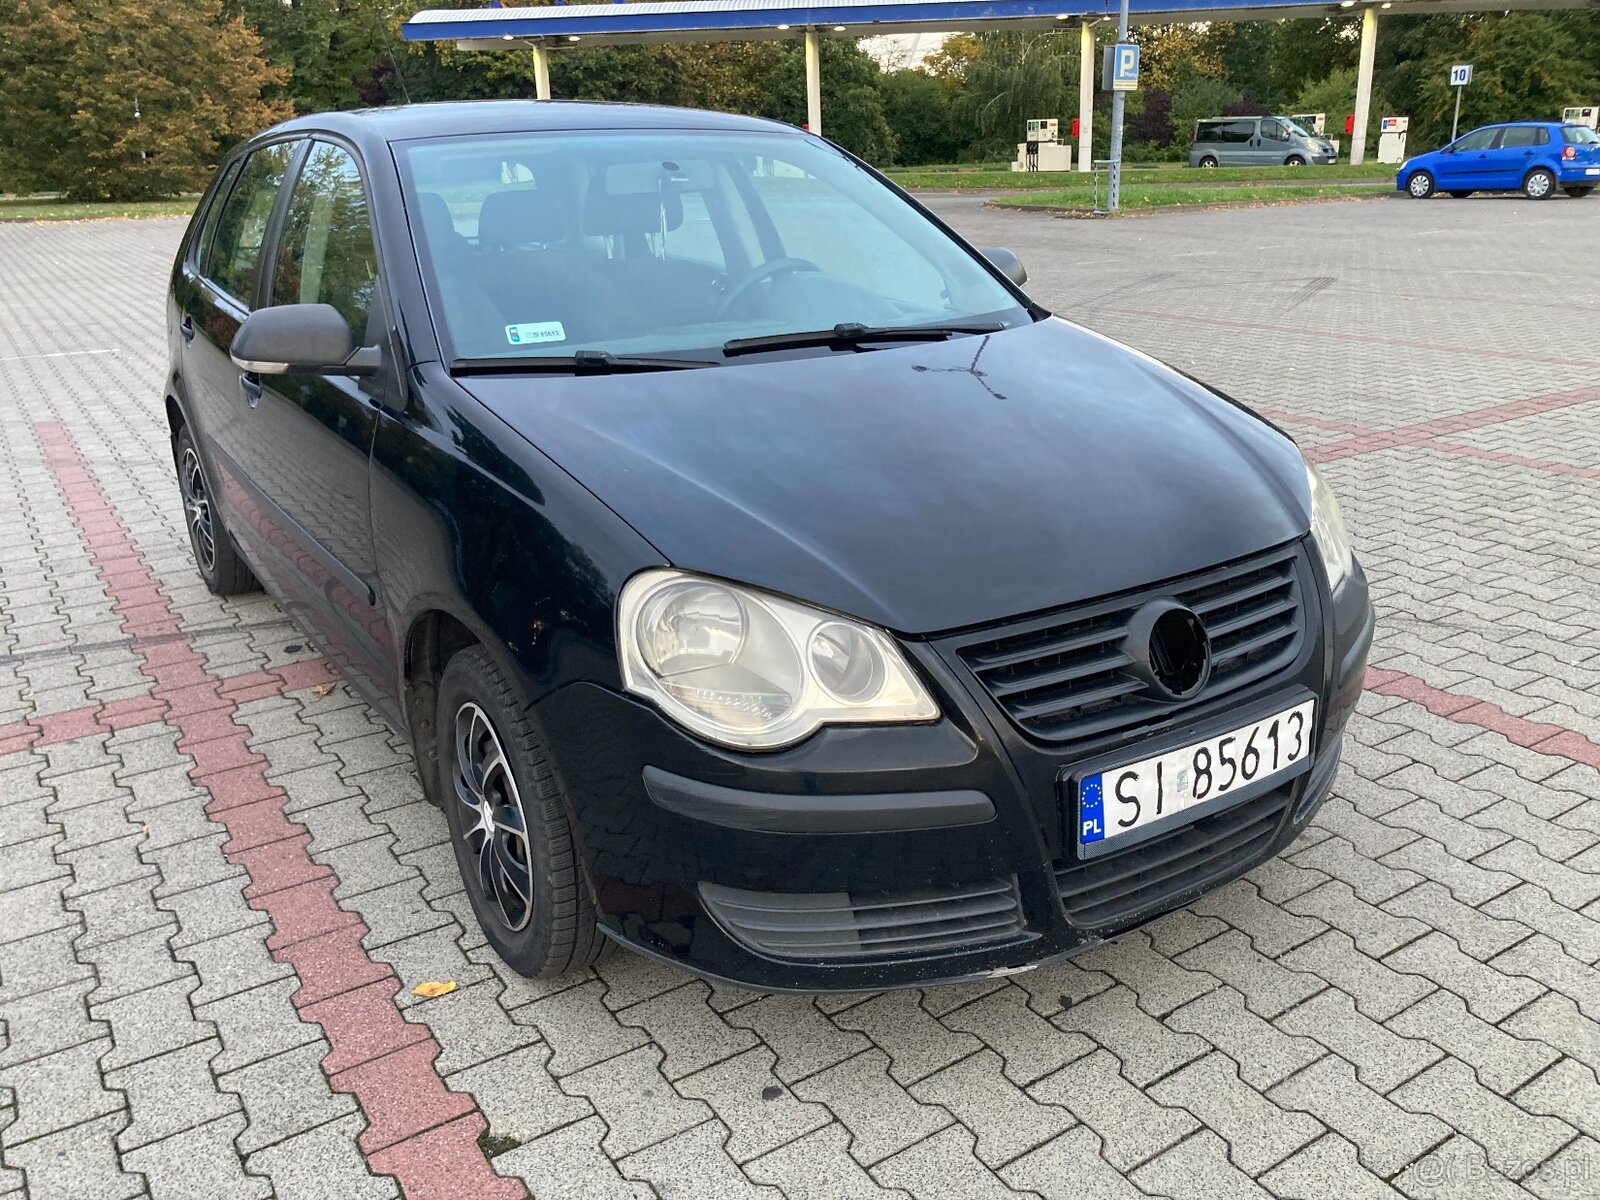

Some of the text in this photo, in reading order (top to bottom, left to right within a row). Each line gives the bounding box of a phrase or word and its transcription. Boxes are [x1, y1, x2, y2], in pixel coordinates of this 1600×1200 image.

[1120, 49, 1135, 77] P
[1453, 69, 1466, 81] 10
[1115, 710, 1304, 828] SI 85613
[1082, 819, 1102, 836] PL
